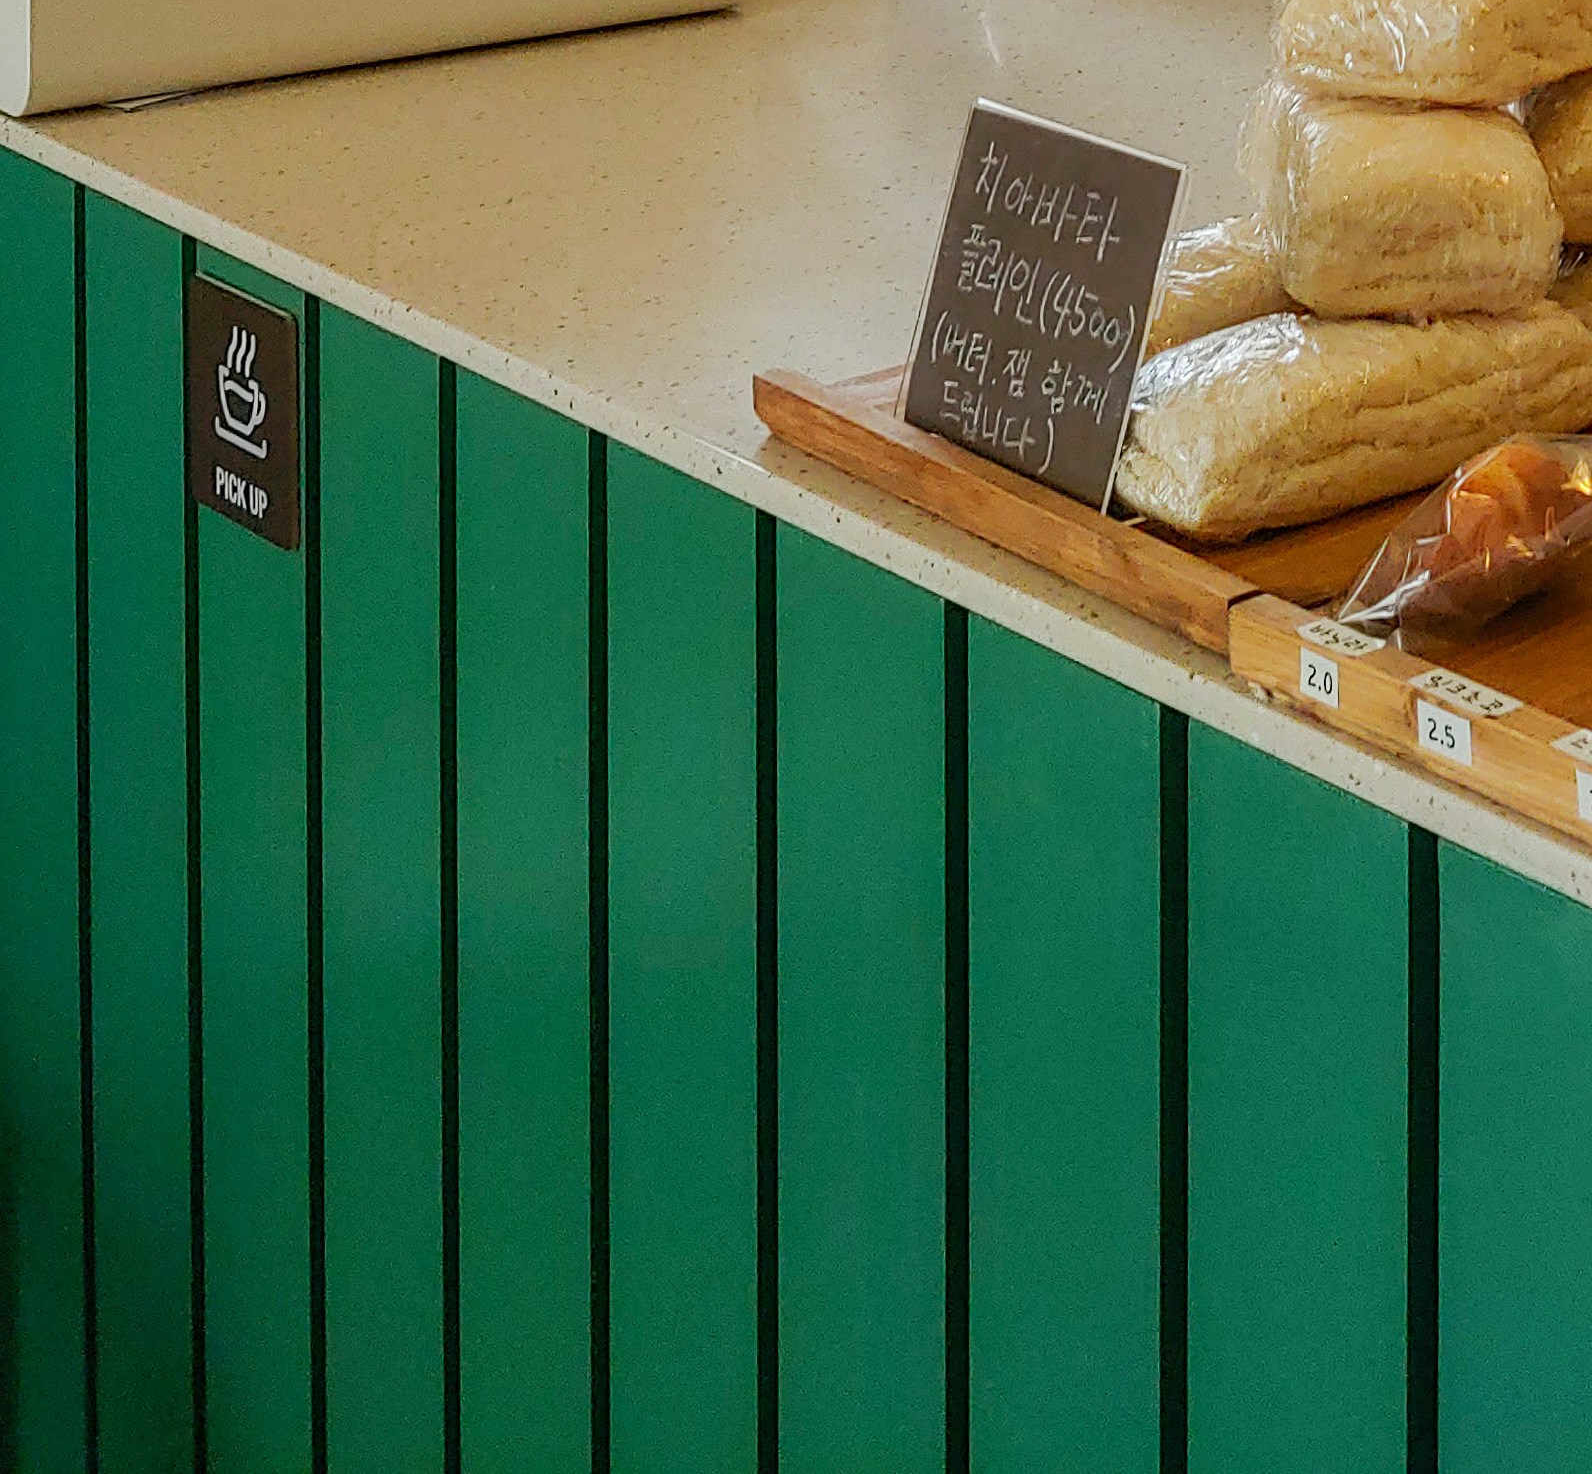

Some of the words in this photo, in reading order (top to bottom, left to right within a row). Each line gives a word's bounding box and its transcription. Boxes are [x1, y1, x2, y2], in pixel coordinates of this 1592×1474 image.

[974, 141, 1121, 262] 치아바타
[1002, 348, 1032, 398] 잼
[1041, 357, 1112, 425] 함께
[215, 465, 246, 510] PICK
[249, 482, 268, 519] UP
[1307, 664, 1333, 695] 2.0
[1427, 717, 1456, 749] 2.5
